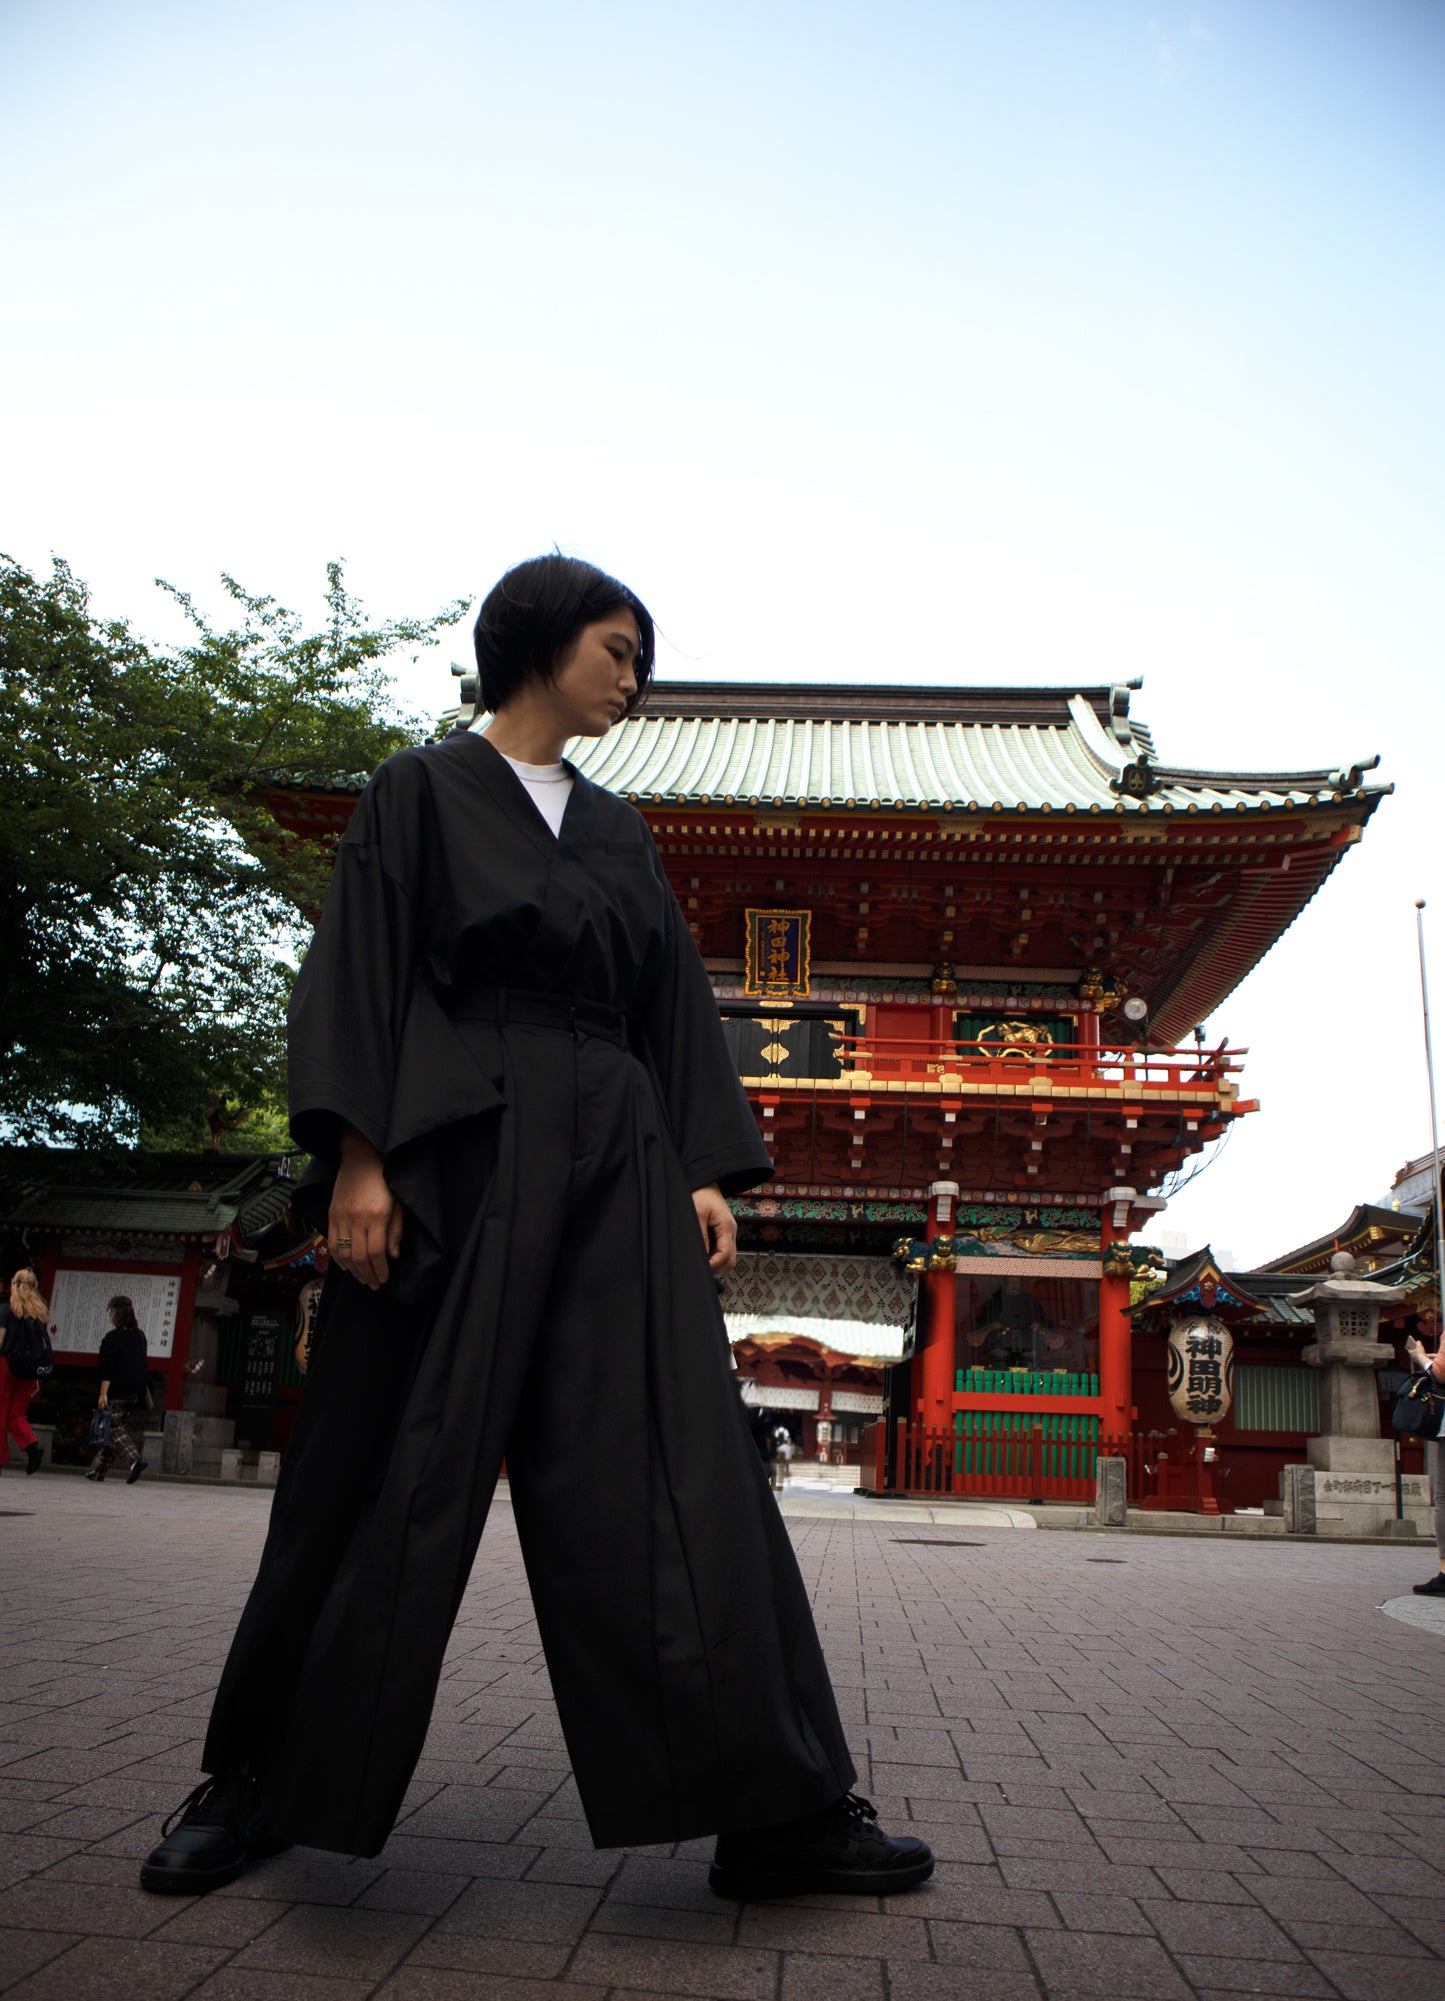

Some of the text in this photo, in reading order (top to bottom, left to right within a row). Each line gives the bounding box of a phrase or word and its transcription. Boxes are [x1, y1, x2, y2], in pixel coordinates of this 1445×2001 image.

[767, 918, 790, 981] 神田神社
[1185, 1335, 1223, 1415] 神田明神
